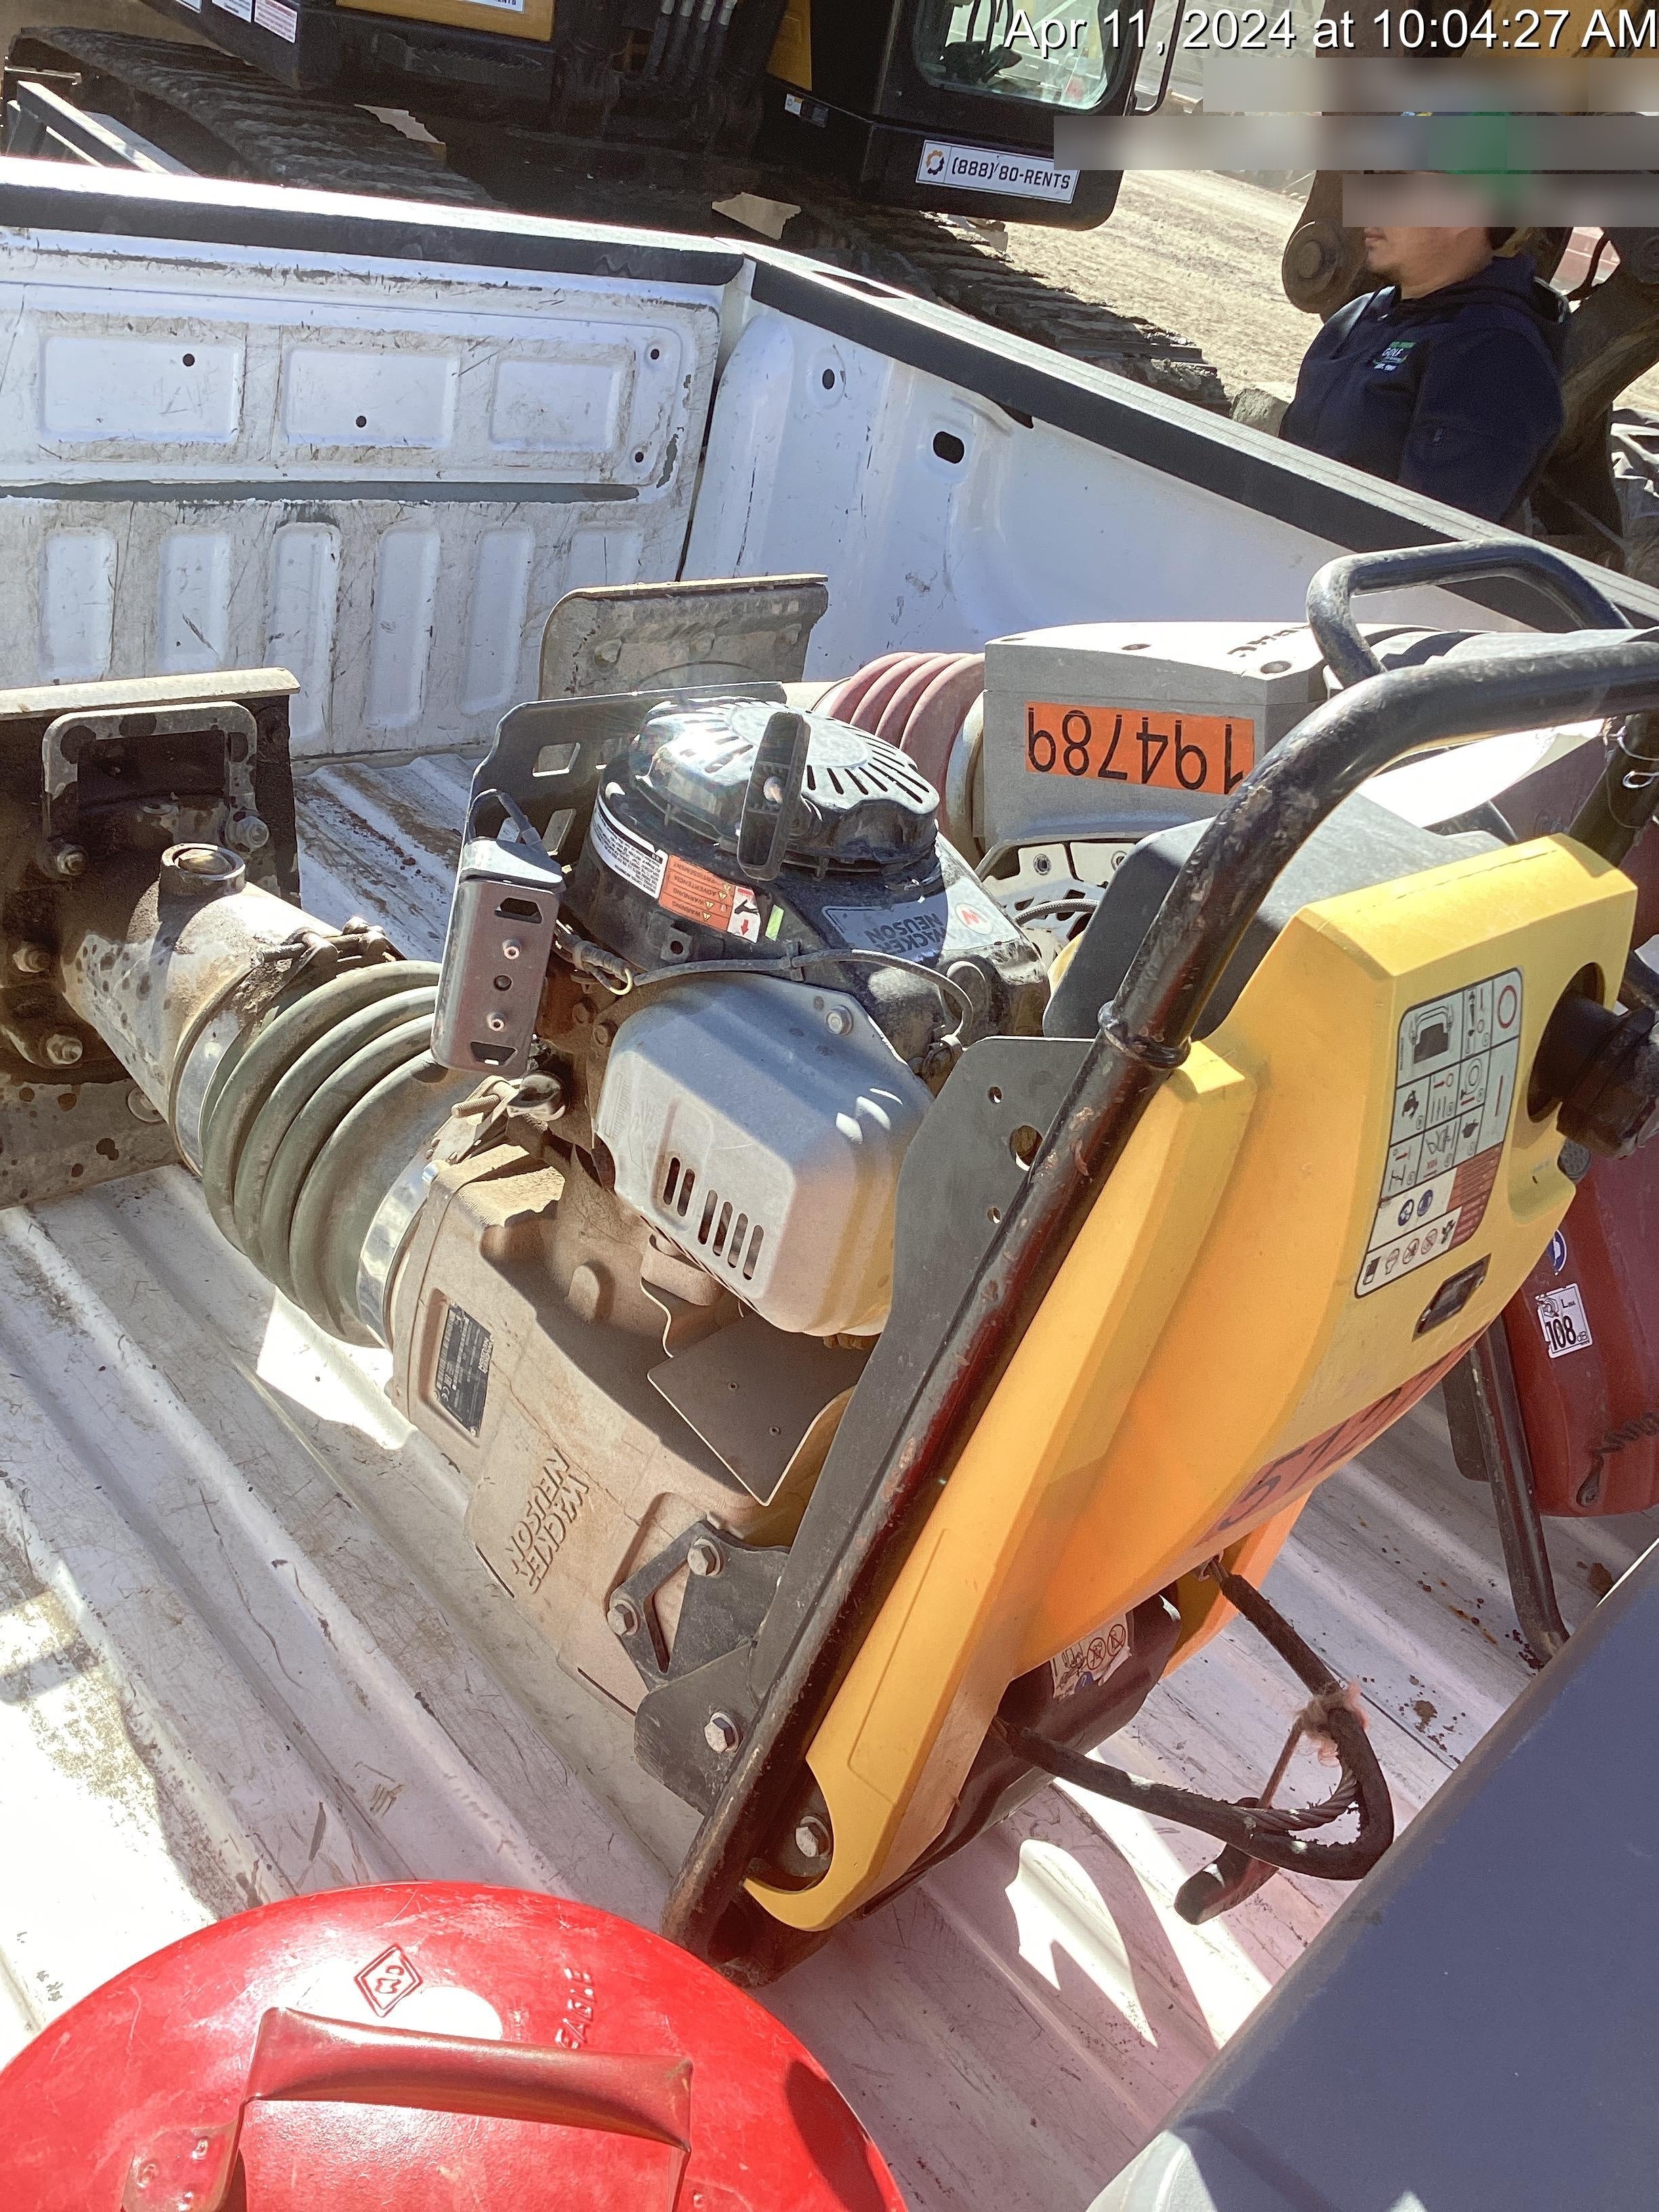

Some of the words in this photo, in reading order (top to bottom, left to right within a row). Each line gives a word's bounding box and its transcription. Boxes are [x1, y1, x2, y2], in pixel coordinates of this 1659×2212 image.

[1028, 708, 1243, 794] 194789
[864, 914, 943, 944] NEUSON
[1545, 1315, 1576, 1351] 108
[506, 1446, 570, 1575] NEUSON
[529, 1473, 590, 1595] WACKER
